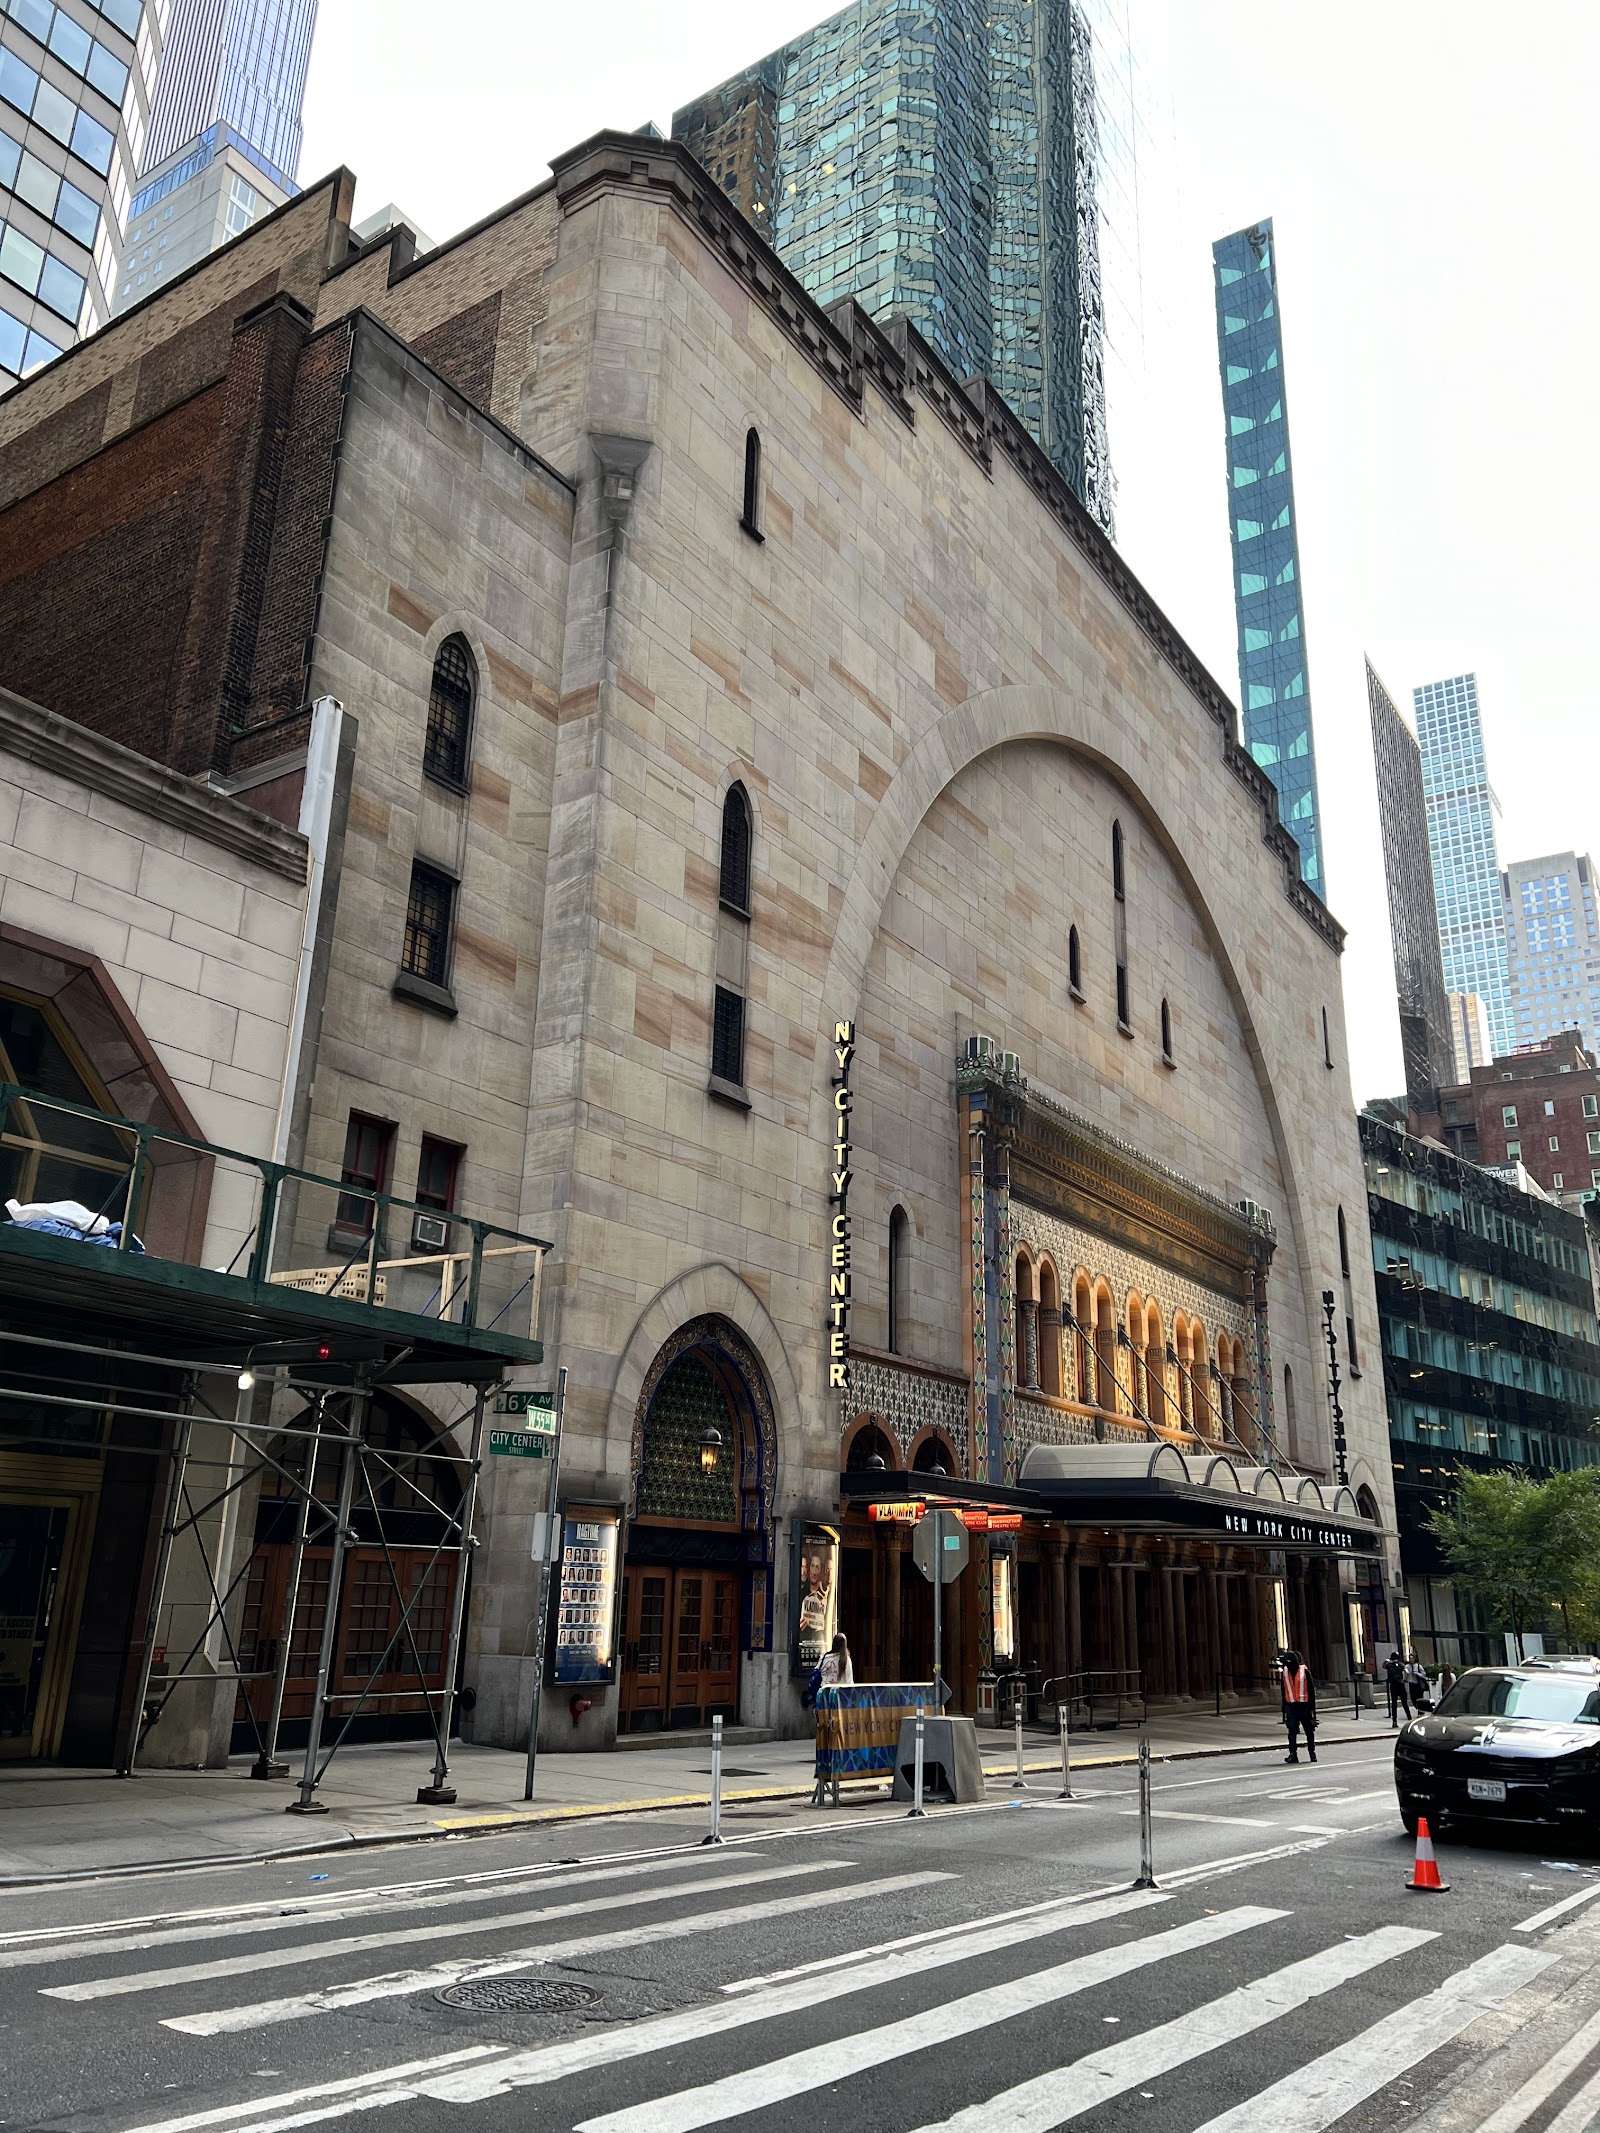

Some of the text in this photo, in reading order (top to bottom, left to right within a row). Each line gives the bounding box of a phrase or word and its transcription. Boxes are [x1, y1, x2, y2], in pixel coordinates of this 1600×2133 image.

[829, 1020, 852, 1389] NY CITY CENTER
[509, 1394, 519, 1412] 6
[528, 1409, 536, 1428] W
[536, 1413, 545, 1430] 55
[490, 1431, 543, 1449] CITY CENTER
[508, 1447, 524, 1455] STREET
[576, 1523, 600, 1540] RAGTIME
[1225, 1514, 1353, 1548] NEW YORK CITY CENTER
[843, 1721, 861, 1735] NEW
[864, 1719, 887, 1734] YORK
